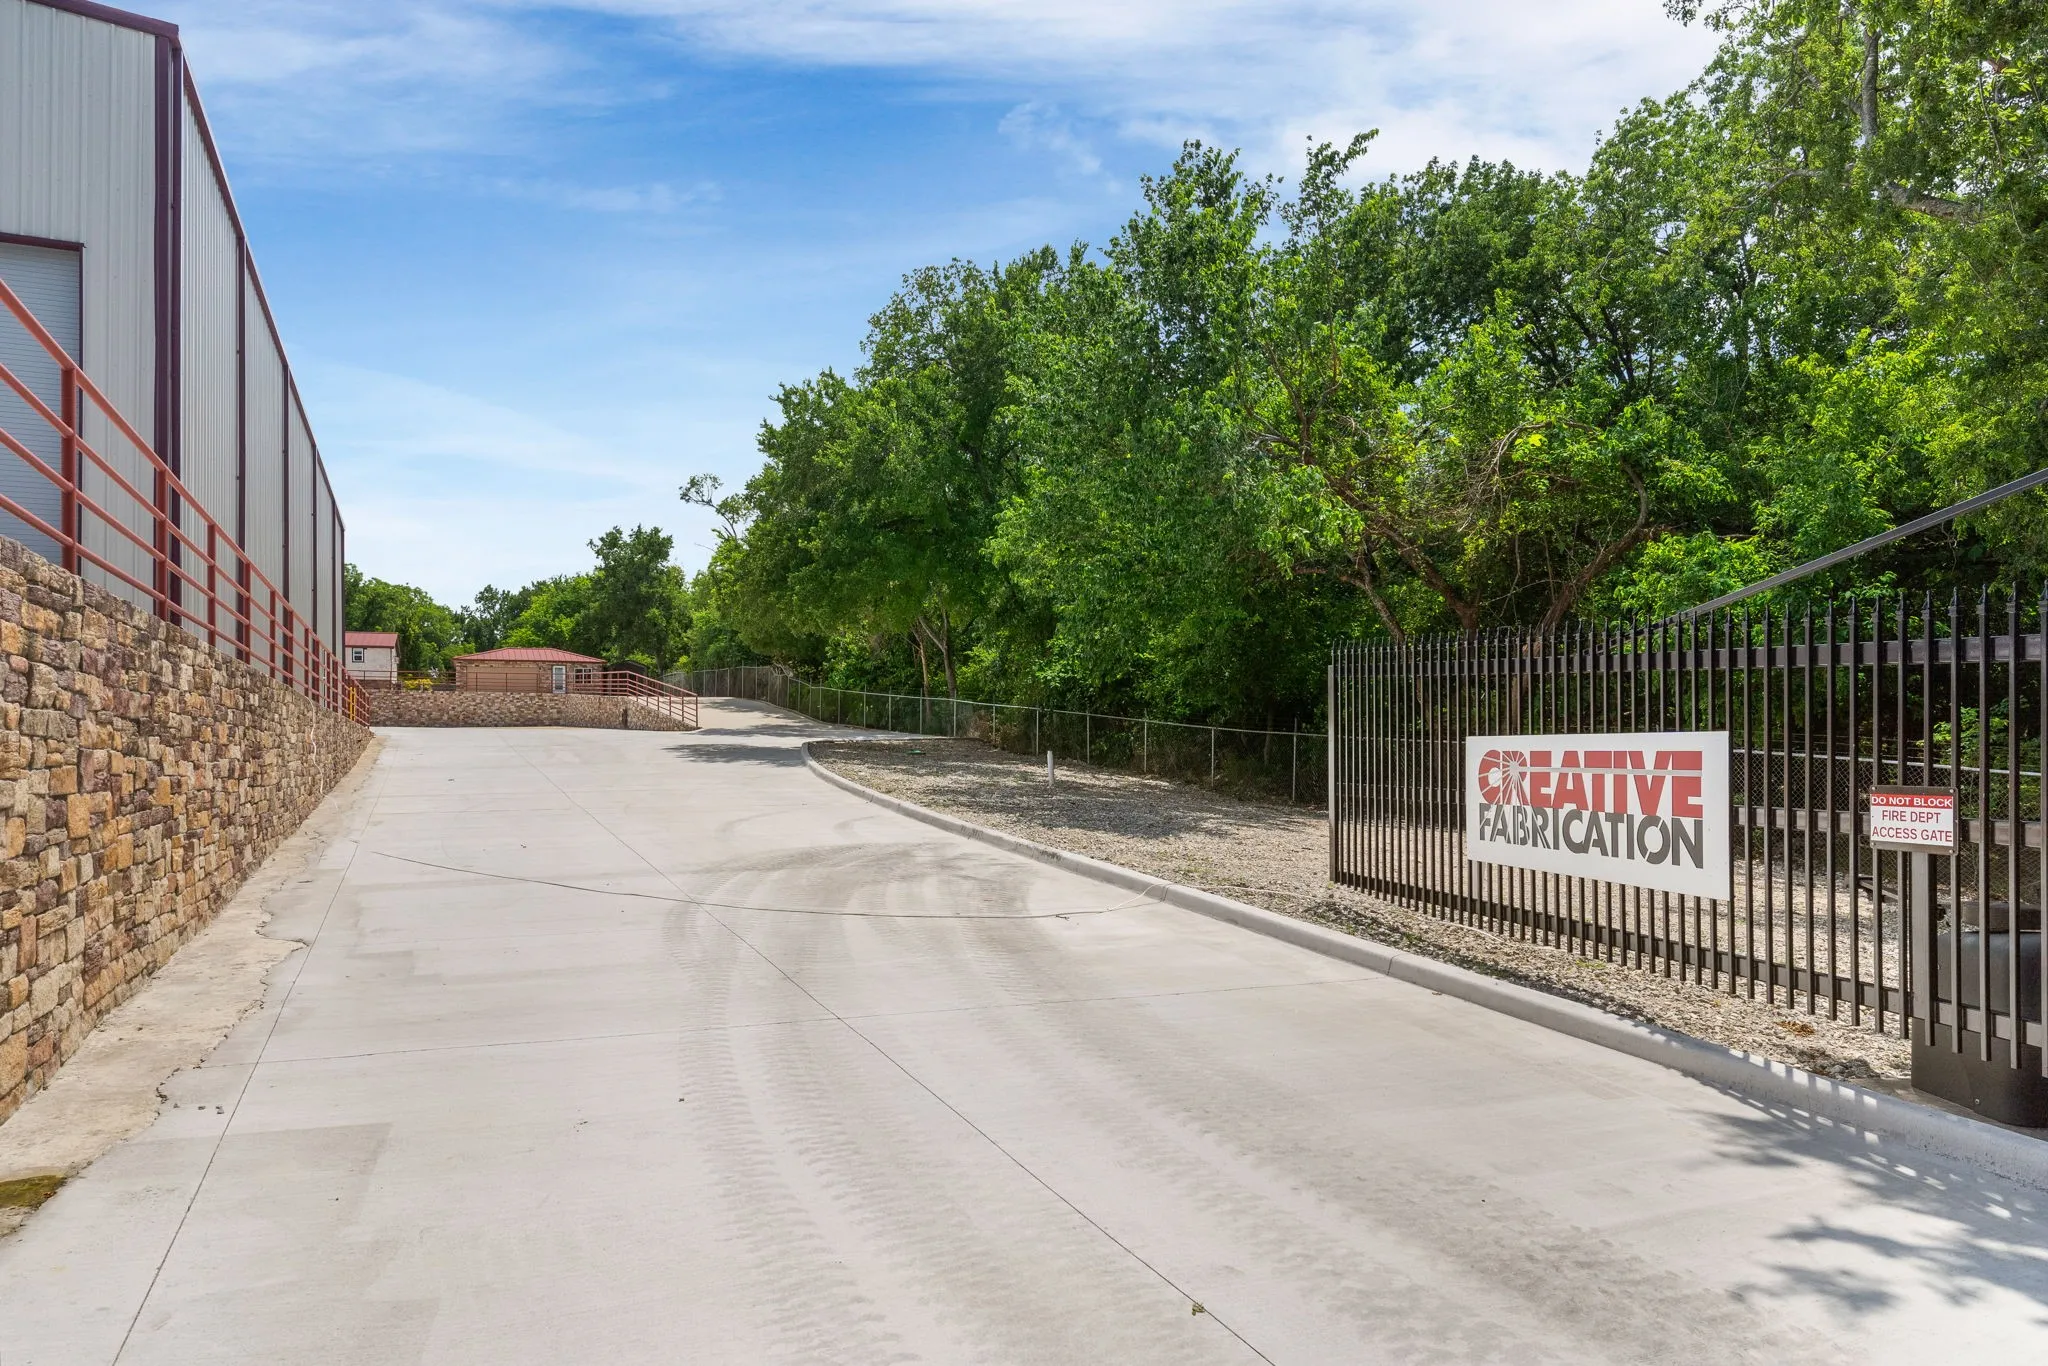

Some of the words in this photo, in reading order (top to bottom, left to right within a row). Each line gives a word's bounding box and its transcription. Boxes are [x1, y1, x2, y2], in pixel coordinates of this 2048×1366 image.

[1478, 749, 1703, 818] CREATIVE
[1871, 796, 1886, 805] DO
[1889, 797, 1911, 805] NOT
[1913, 797, 1952, 807] BLOCK
[1882, 810, 1907, 822] FIRE
[1910, 811, 1941, 824] DEPT
[1479, 802, 1704, 869] FABRICATION
[1872, 826, 1917, 840] ACCESS
[1920, 829, 1952, 842] GATE
